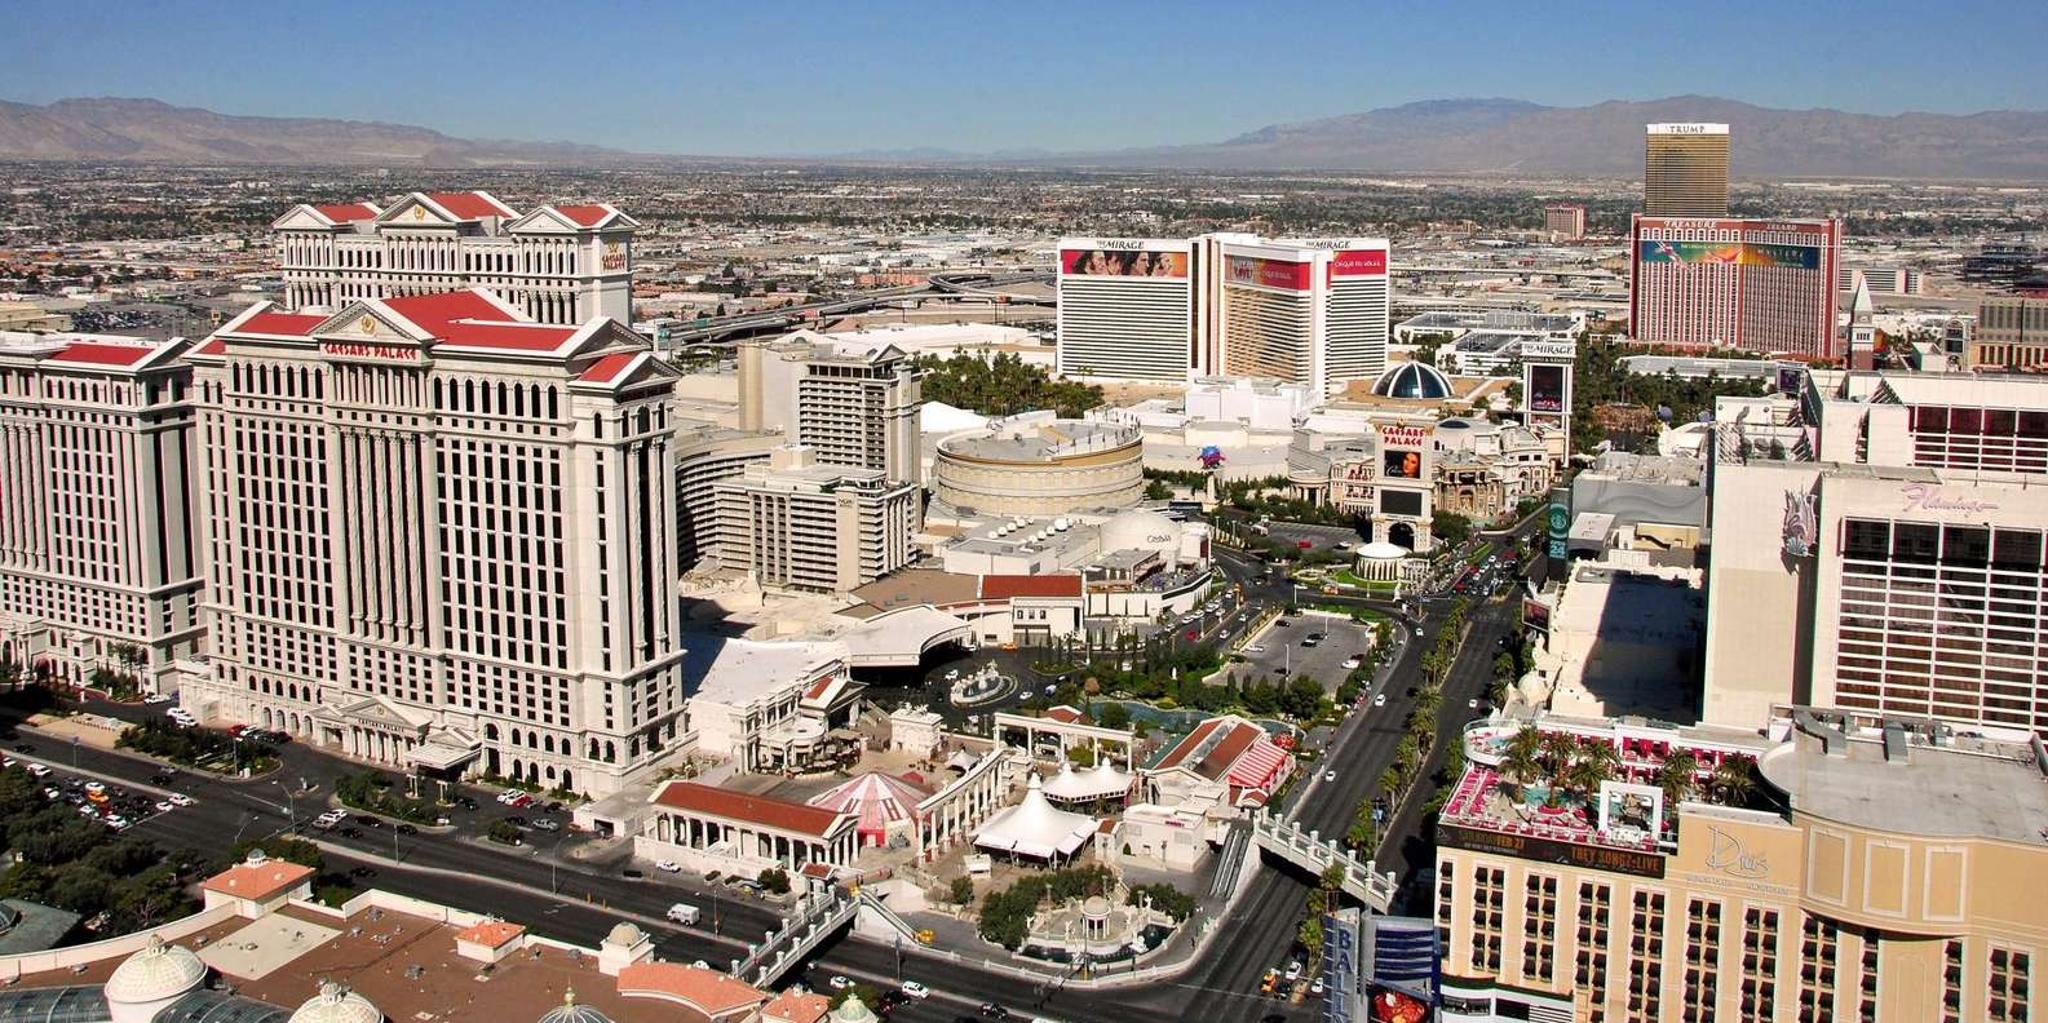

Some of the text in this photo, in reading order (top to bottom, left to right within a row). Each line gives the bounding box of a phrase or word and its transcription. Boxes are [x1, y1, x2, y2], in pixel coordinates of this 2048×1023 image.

[1669, 125, 1705, 133] TRUMP
[1663, 220, 1717, 228] TREASURE
[1766, 223, 1798, 231] ISLAND
[1105, 241, 1145, 249] MIRAGE
[1314, 241, 1352, 249] MIRAGE
[325, 342, 417, 360] CAESARS PALACE
[1536, 344, 1574, 354] MIRAGE
[1382, 427, 1425, 437] CAESARS
[1384, 436, 1423, 446] PALACE
[1901, 485, 1999, 514] Flamingo
